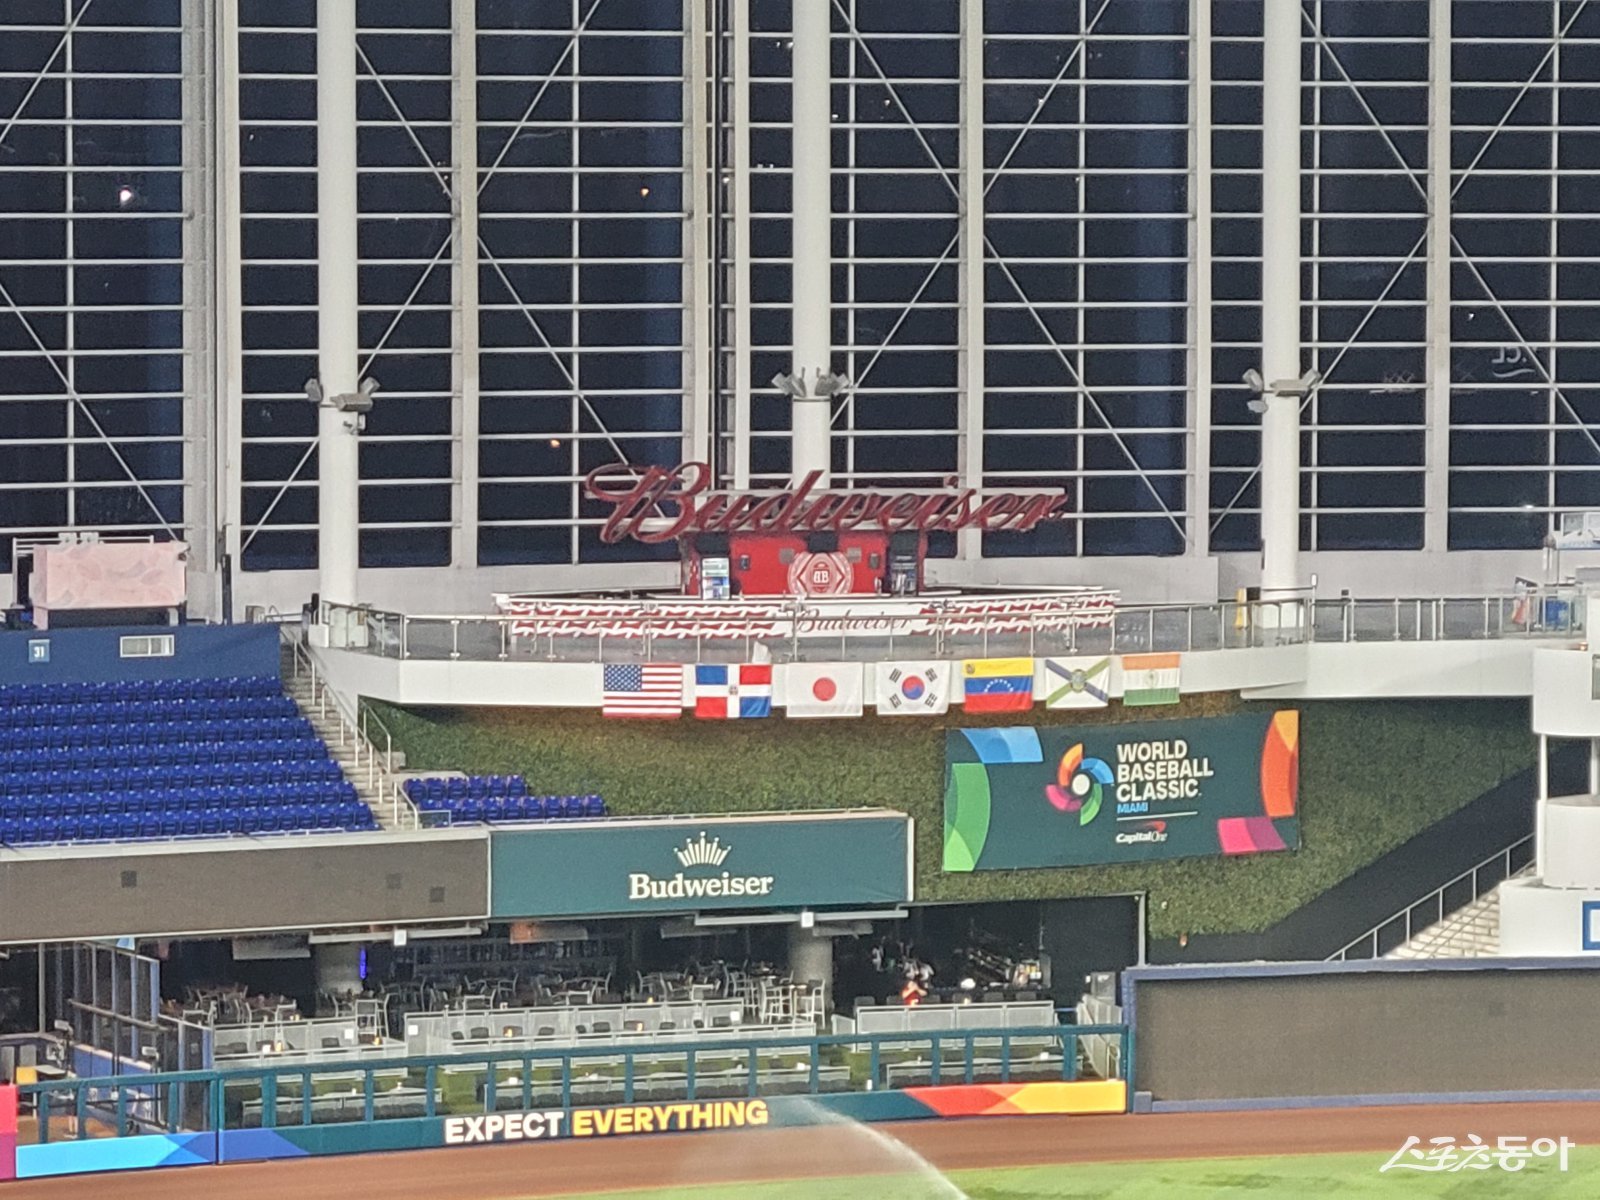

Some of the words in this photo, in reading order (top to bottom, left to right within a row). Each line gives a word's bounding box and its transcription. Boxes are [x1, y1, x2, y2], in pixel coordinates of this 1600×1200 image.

[585, 461, 1068, 544] Budweiser
[796, 608, 911, 633] Budweiser
[1117, 740, 1188, 763] WORLD
[1117, 757, 1214, 784] BASEBALL
[1116, 778, 1199, 802] CLASSIC
[1117, 802, 1148, 814] MIAMI
[629, 871, 774, 900] Budweiser
[445, 1111, 564, 1143] EXPECT
[573, 1100, 768, 1136] EVERYTHING
